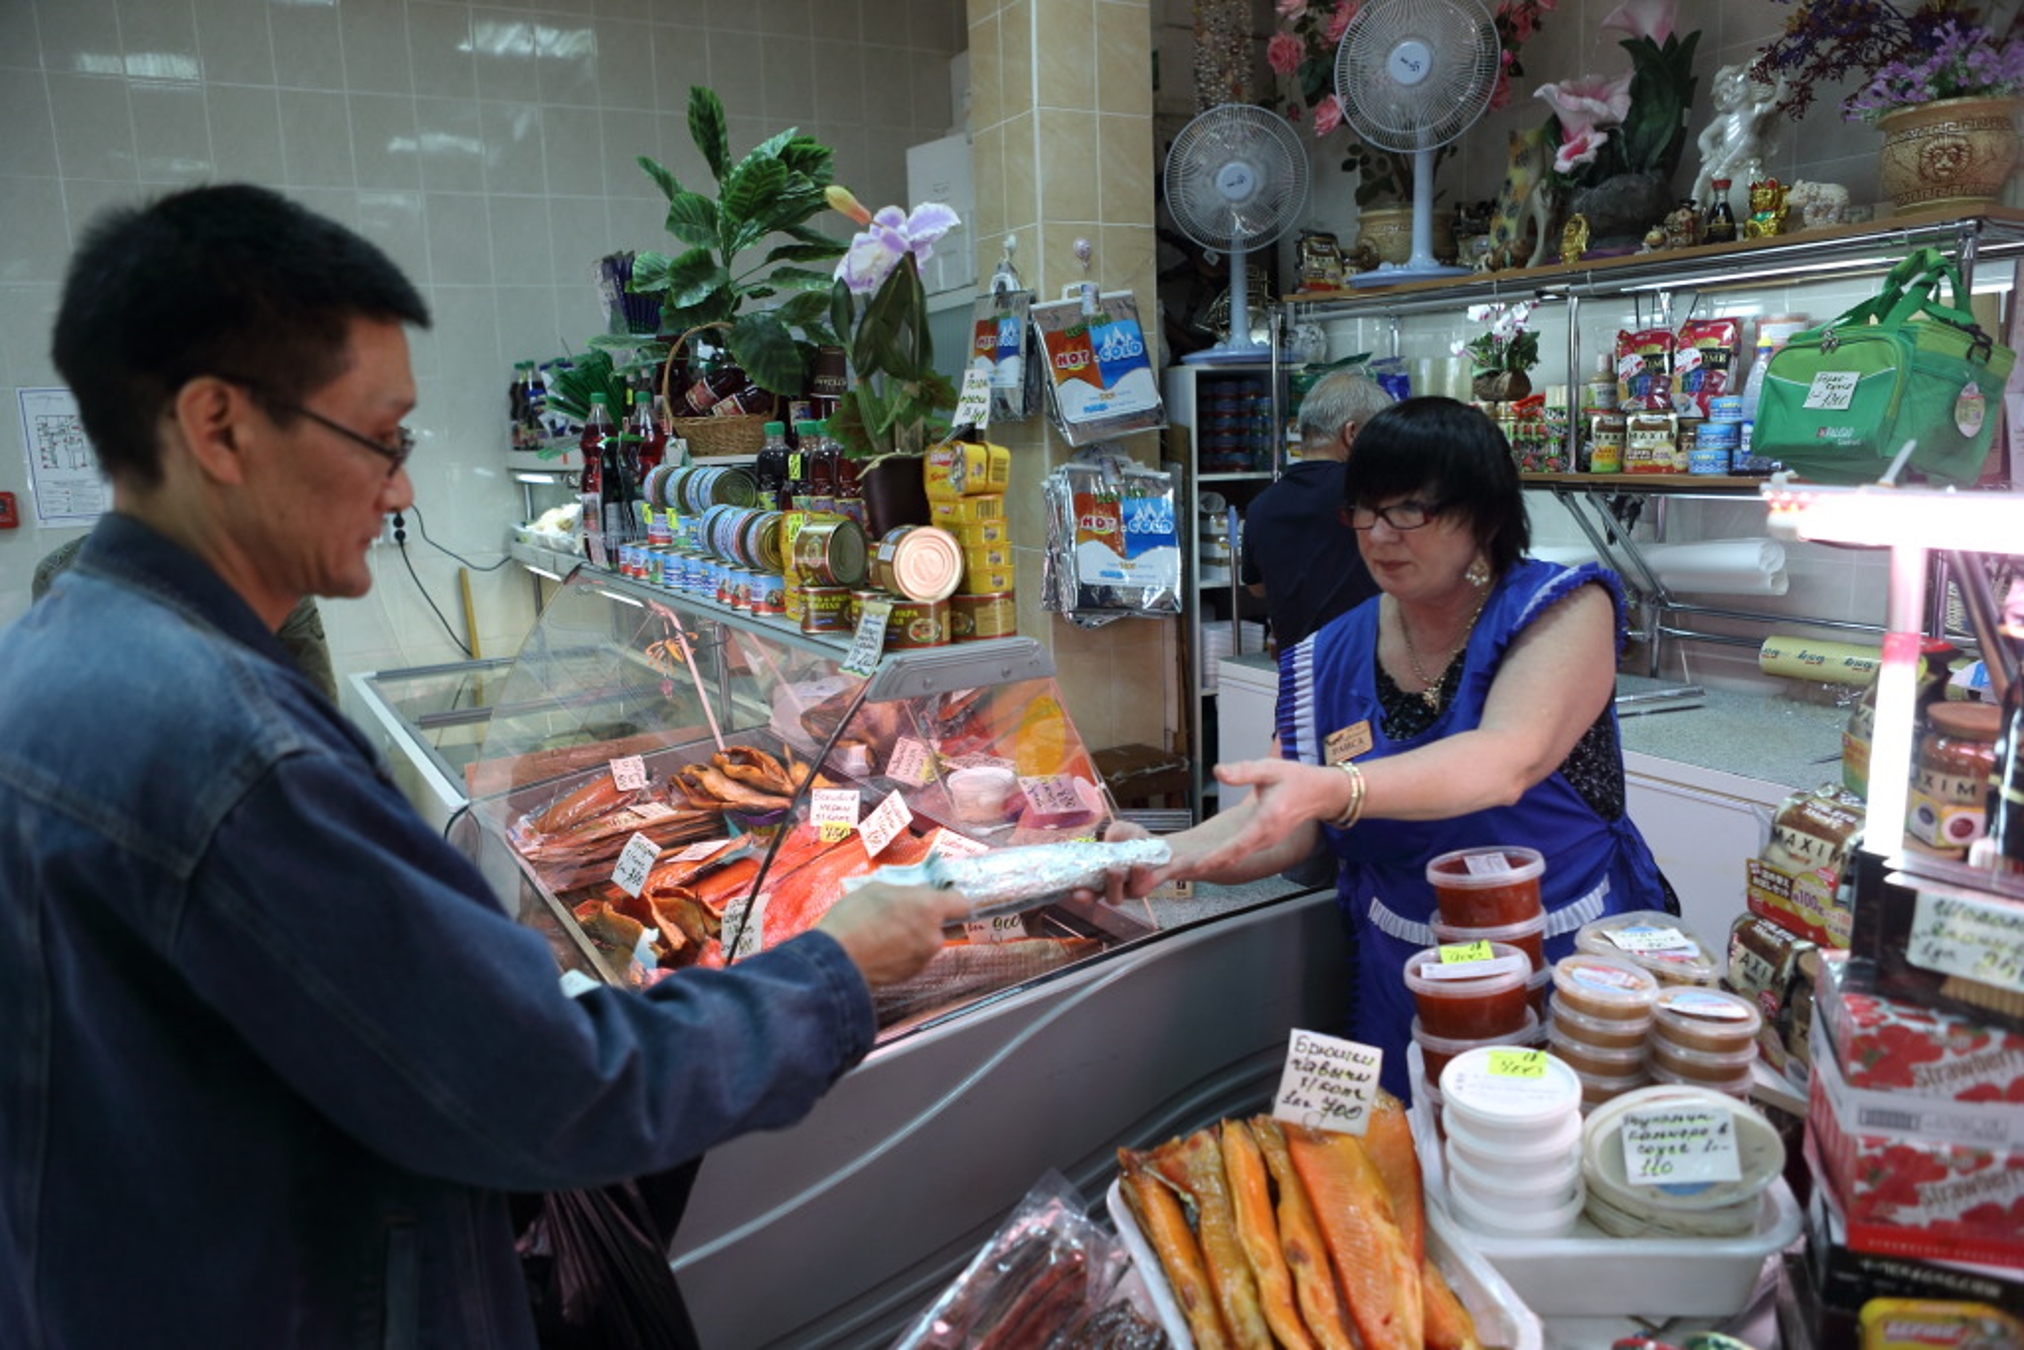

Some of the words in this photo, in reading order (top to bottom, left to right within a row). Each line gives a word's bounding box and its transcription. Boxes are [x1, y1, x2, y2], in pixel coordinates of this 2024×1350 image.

[1056, 350, 1090, 368] HOT
[1099, 338, 1143, 361] COLD
[1082, 515, 1117, 532] HOT
[1921, 773, 1977, 797] XIM
[1772, 825, 1846, 864] MAXIM
[1321, 1097, 1362, 1119] 700
